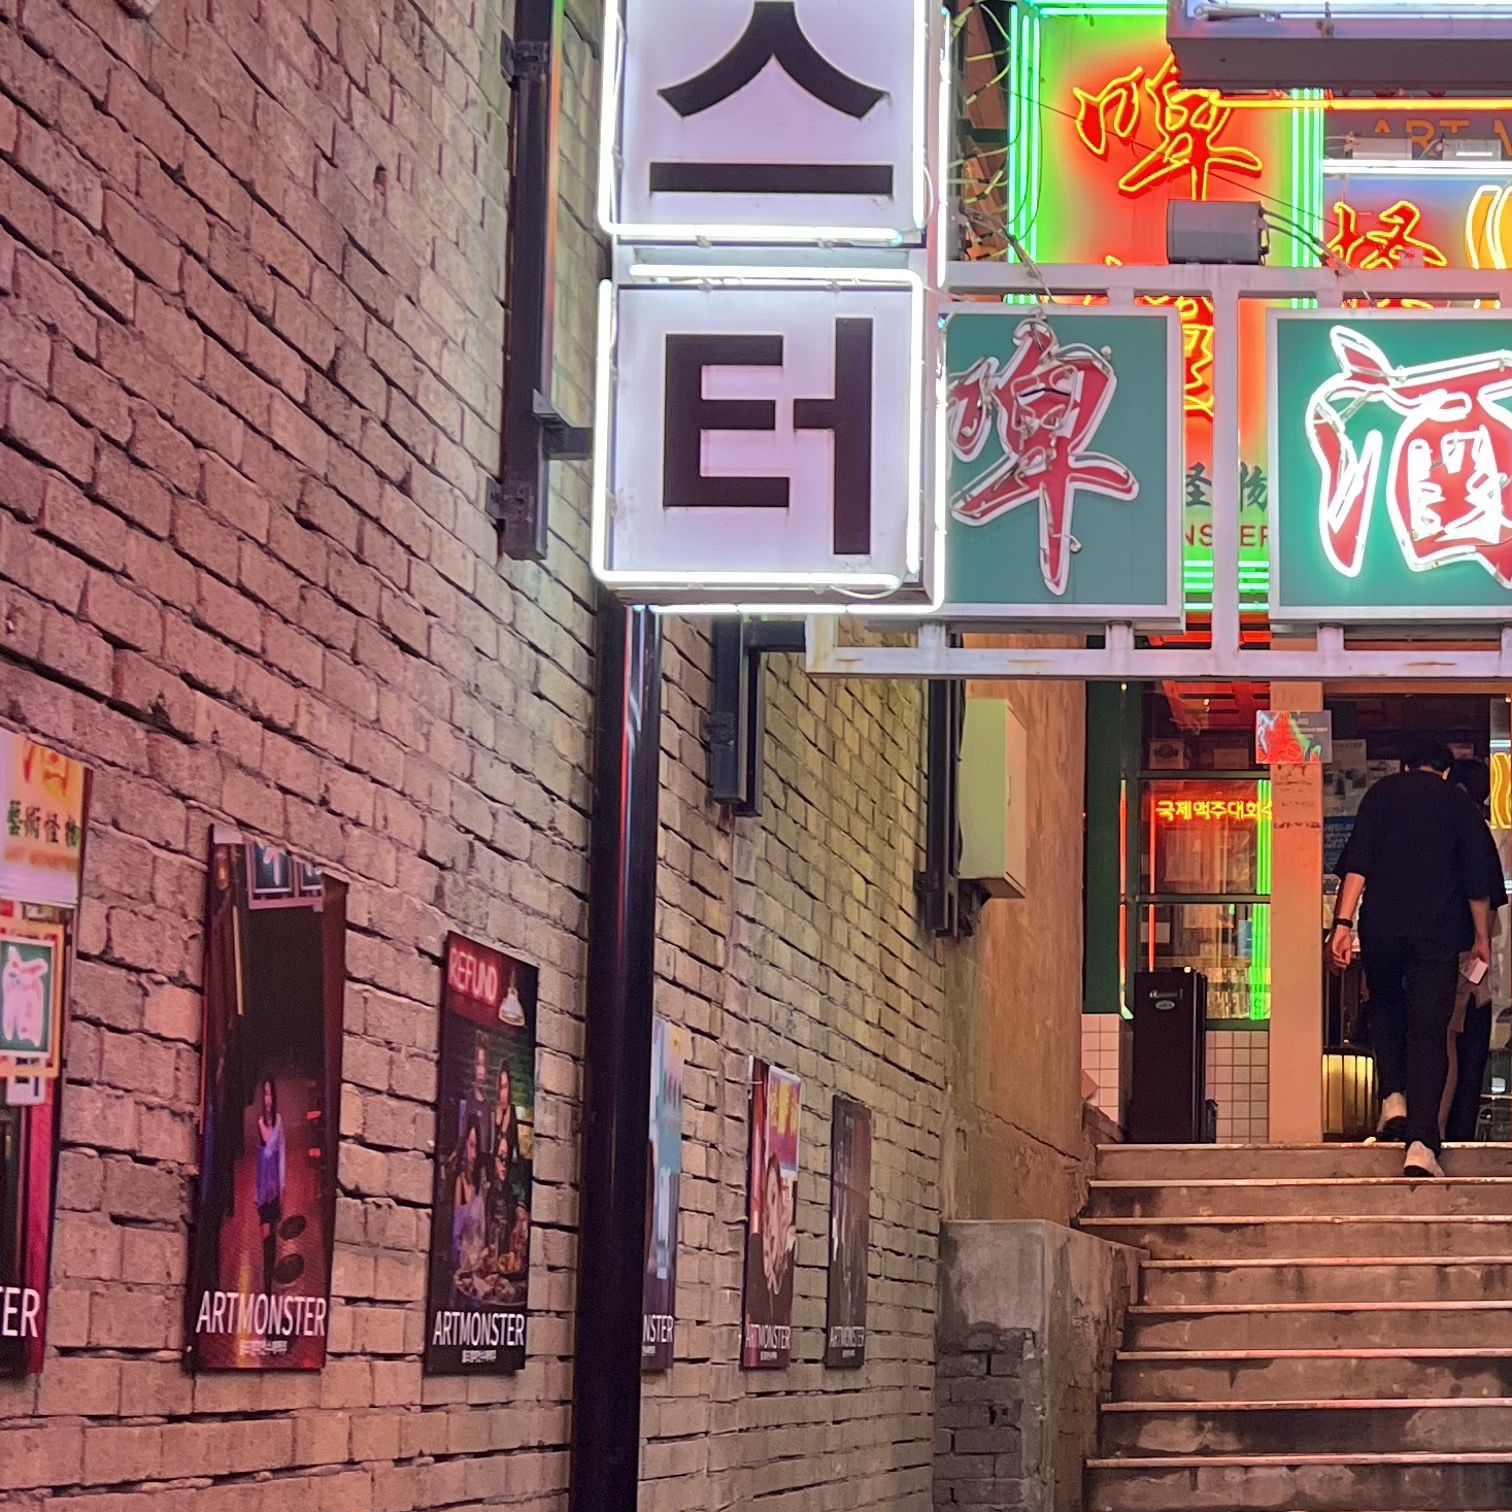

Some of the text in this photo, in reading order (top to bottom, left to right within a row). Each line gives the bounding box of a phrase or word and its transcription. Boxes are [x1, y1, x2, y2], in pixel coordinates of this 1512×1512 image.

[447, 946, 498, 1005] REFUND
[195, 1289, 327, 1337] ARTMONSTER
[432, 1310, 525, 1346] ARTMONSTER
